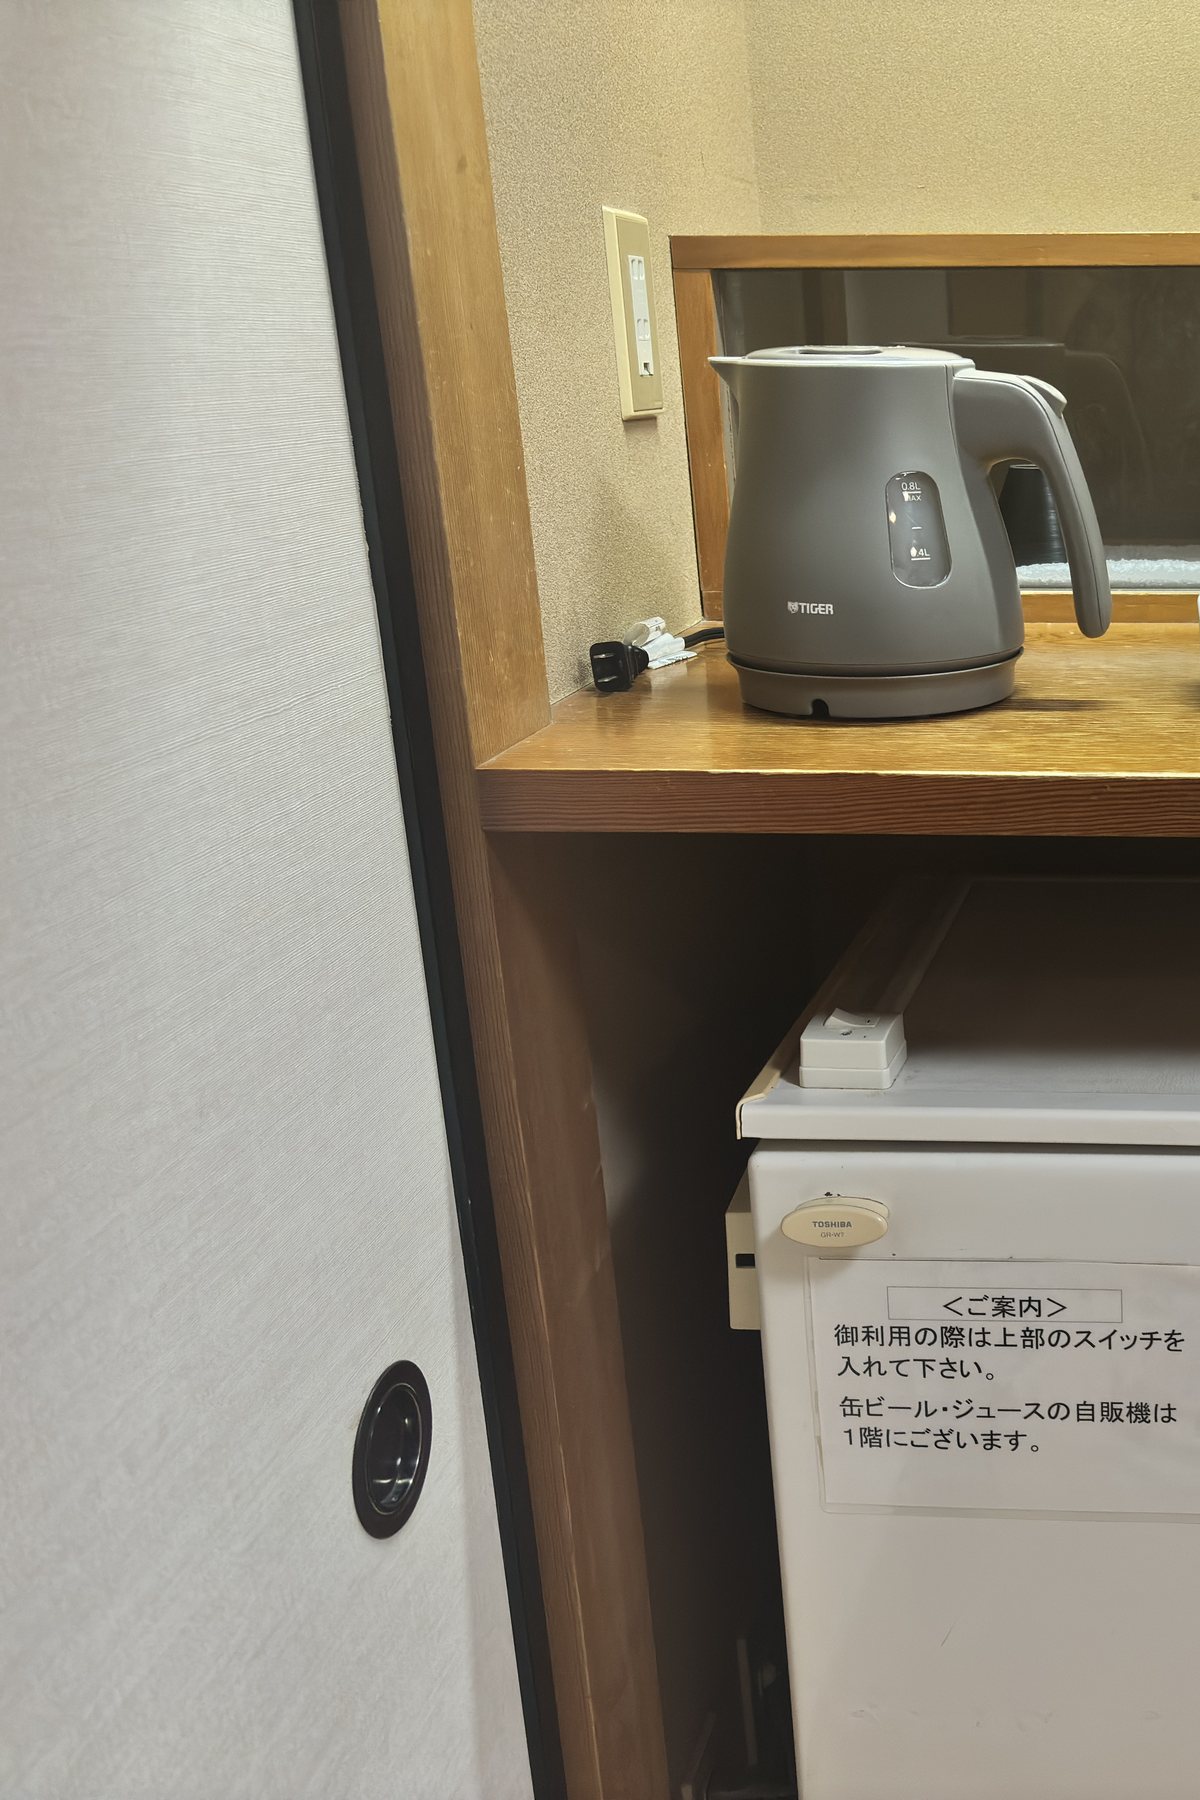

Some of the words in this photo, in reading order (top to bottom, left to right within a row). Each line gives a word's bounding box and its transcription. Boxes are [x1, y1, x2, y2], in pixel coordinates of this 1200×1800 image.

[901, 482, 921, 491] 0.8L
[798, 602, 834, 615] TIGER
[812, 1221, 853, 1229] TOSHIBA
[834, 1323, 1185, 1353] 御利用の際は上部のスイッチを
[837, 1355, 996, 1381] 入れて下さい。
[839, 1396, 1178, 1424] 缶ビール・ジュースの自販機は
